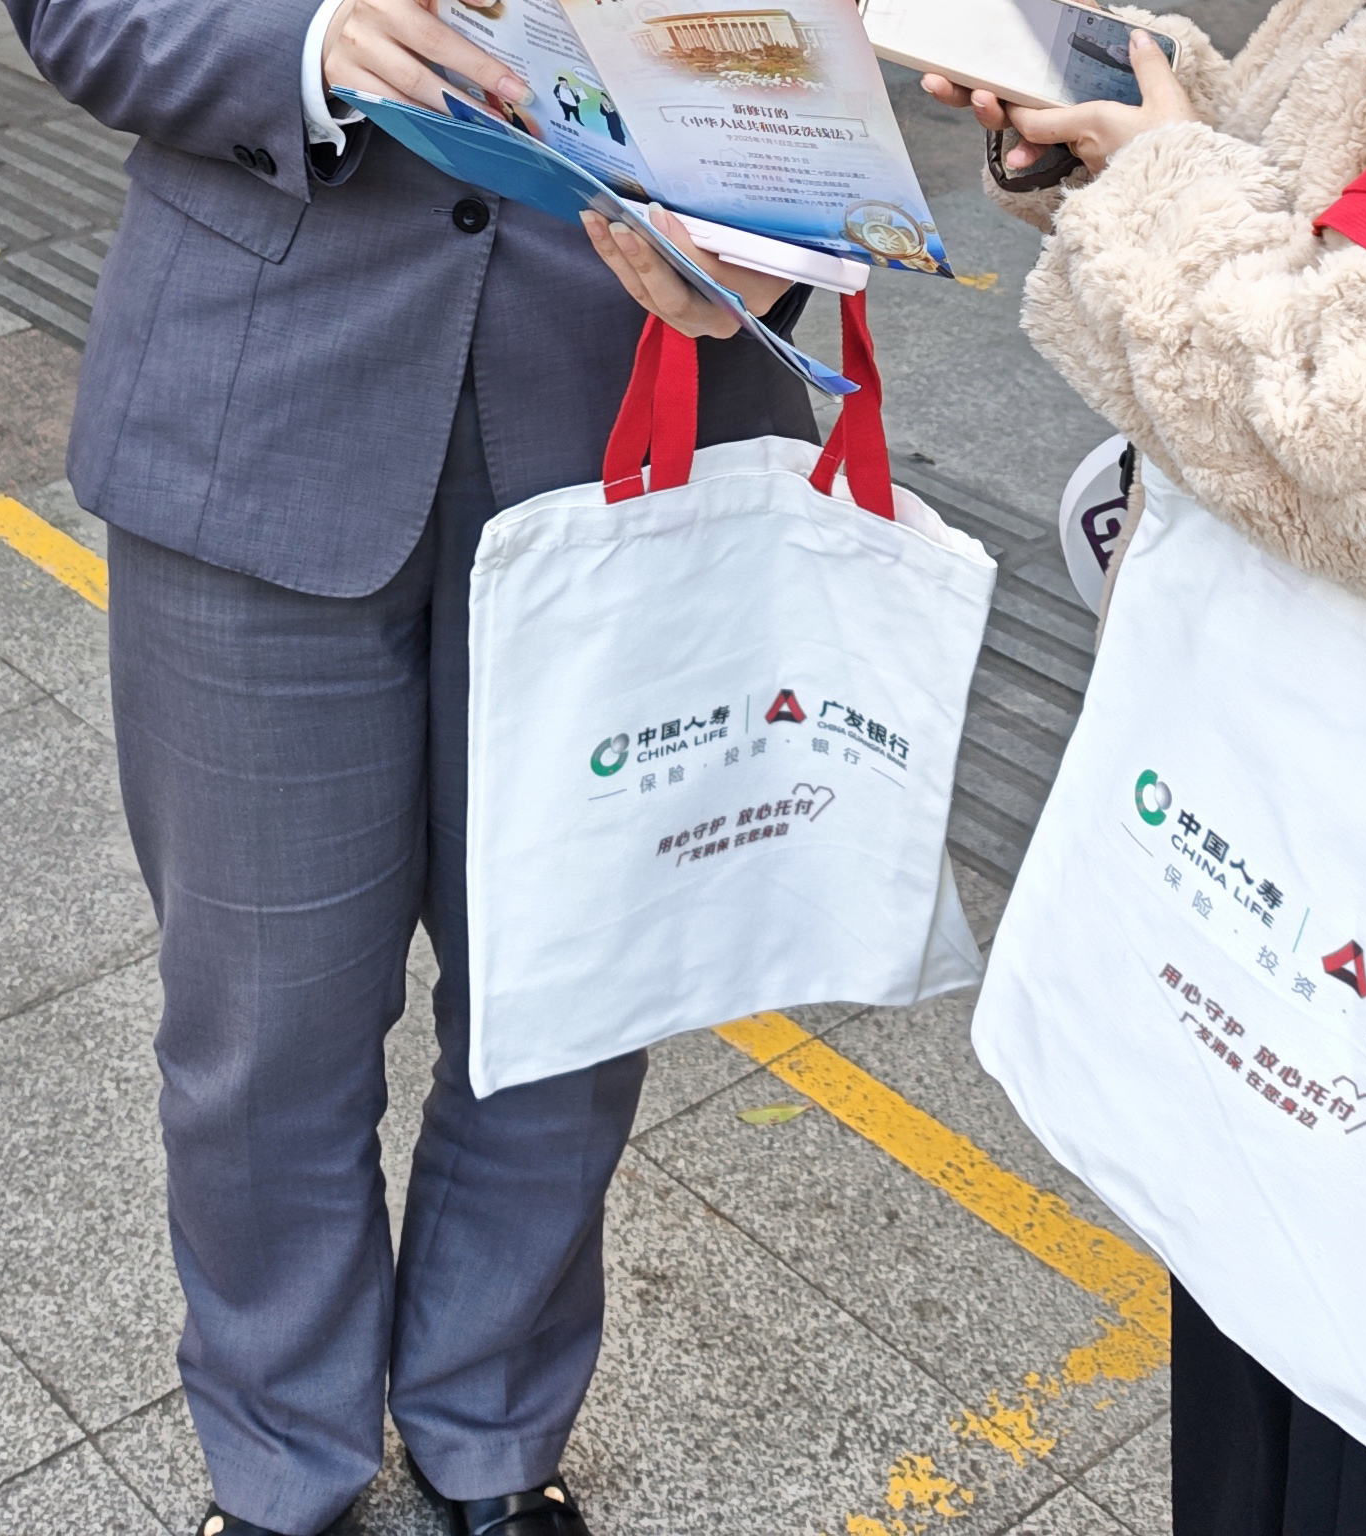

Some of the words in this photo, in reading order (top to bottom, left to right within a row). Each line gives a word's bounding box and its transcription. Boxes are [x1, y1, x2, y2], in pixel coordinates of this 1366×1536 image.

[733, 103, 788, 120] 新修订的
[636, 739, 688, 763] CHINA
[694, 726, 729, 746] LIFE
[637, 705, 731, 748] 中国人寿
[817, 720, 847, 737] CHINA
[818, 699, 910, 760] 广发银行
[656, 815, 727, 857] 用心守护
[736, 799, 815, 828] 放心托付
[733, 822, 790, 848] 在您身边
[1170, 833, 1228, 891] CHINA
[1233, 885, 1275, 929] LIFE
[1176, 809, 1285, 911] 中国人寿
[1158, 962, 1246, 1038] 用心守护
[1252, 1044, 1356, 1123] 放心托付
[1178, 1010, 1244, 1074] 广发消保
[1244, 1068, 1319, 1131] 在您身边
